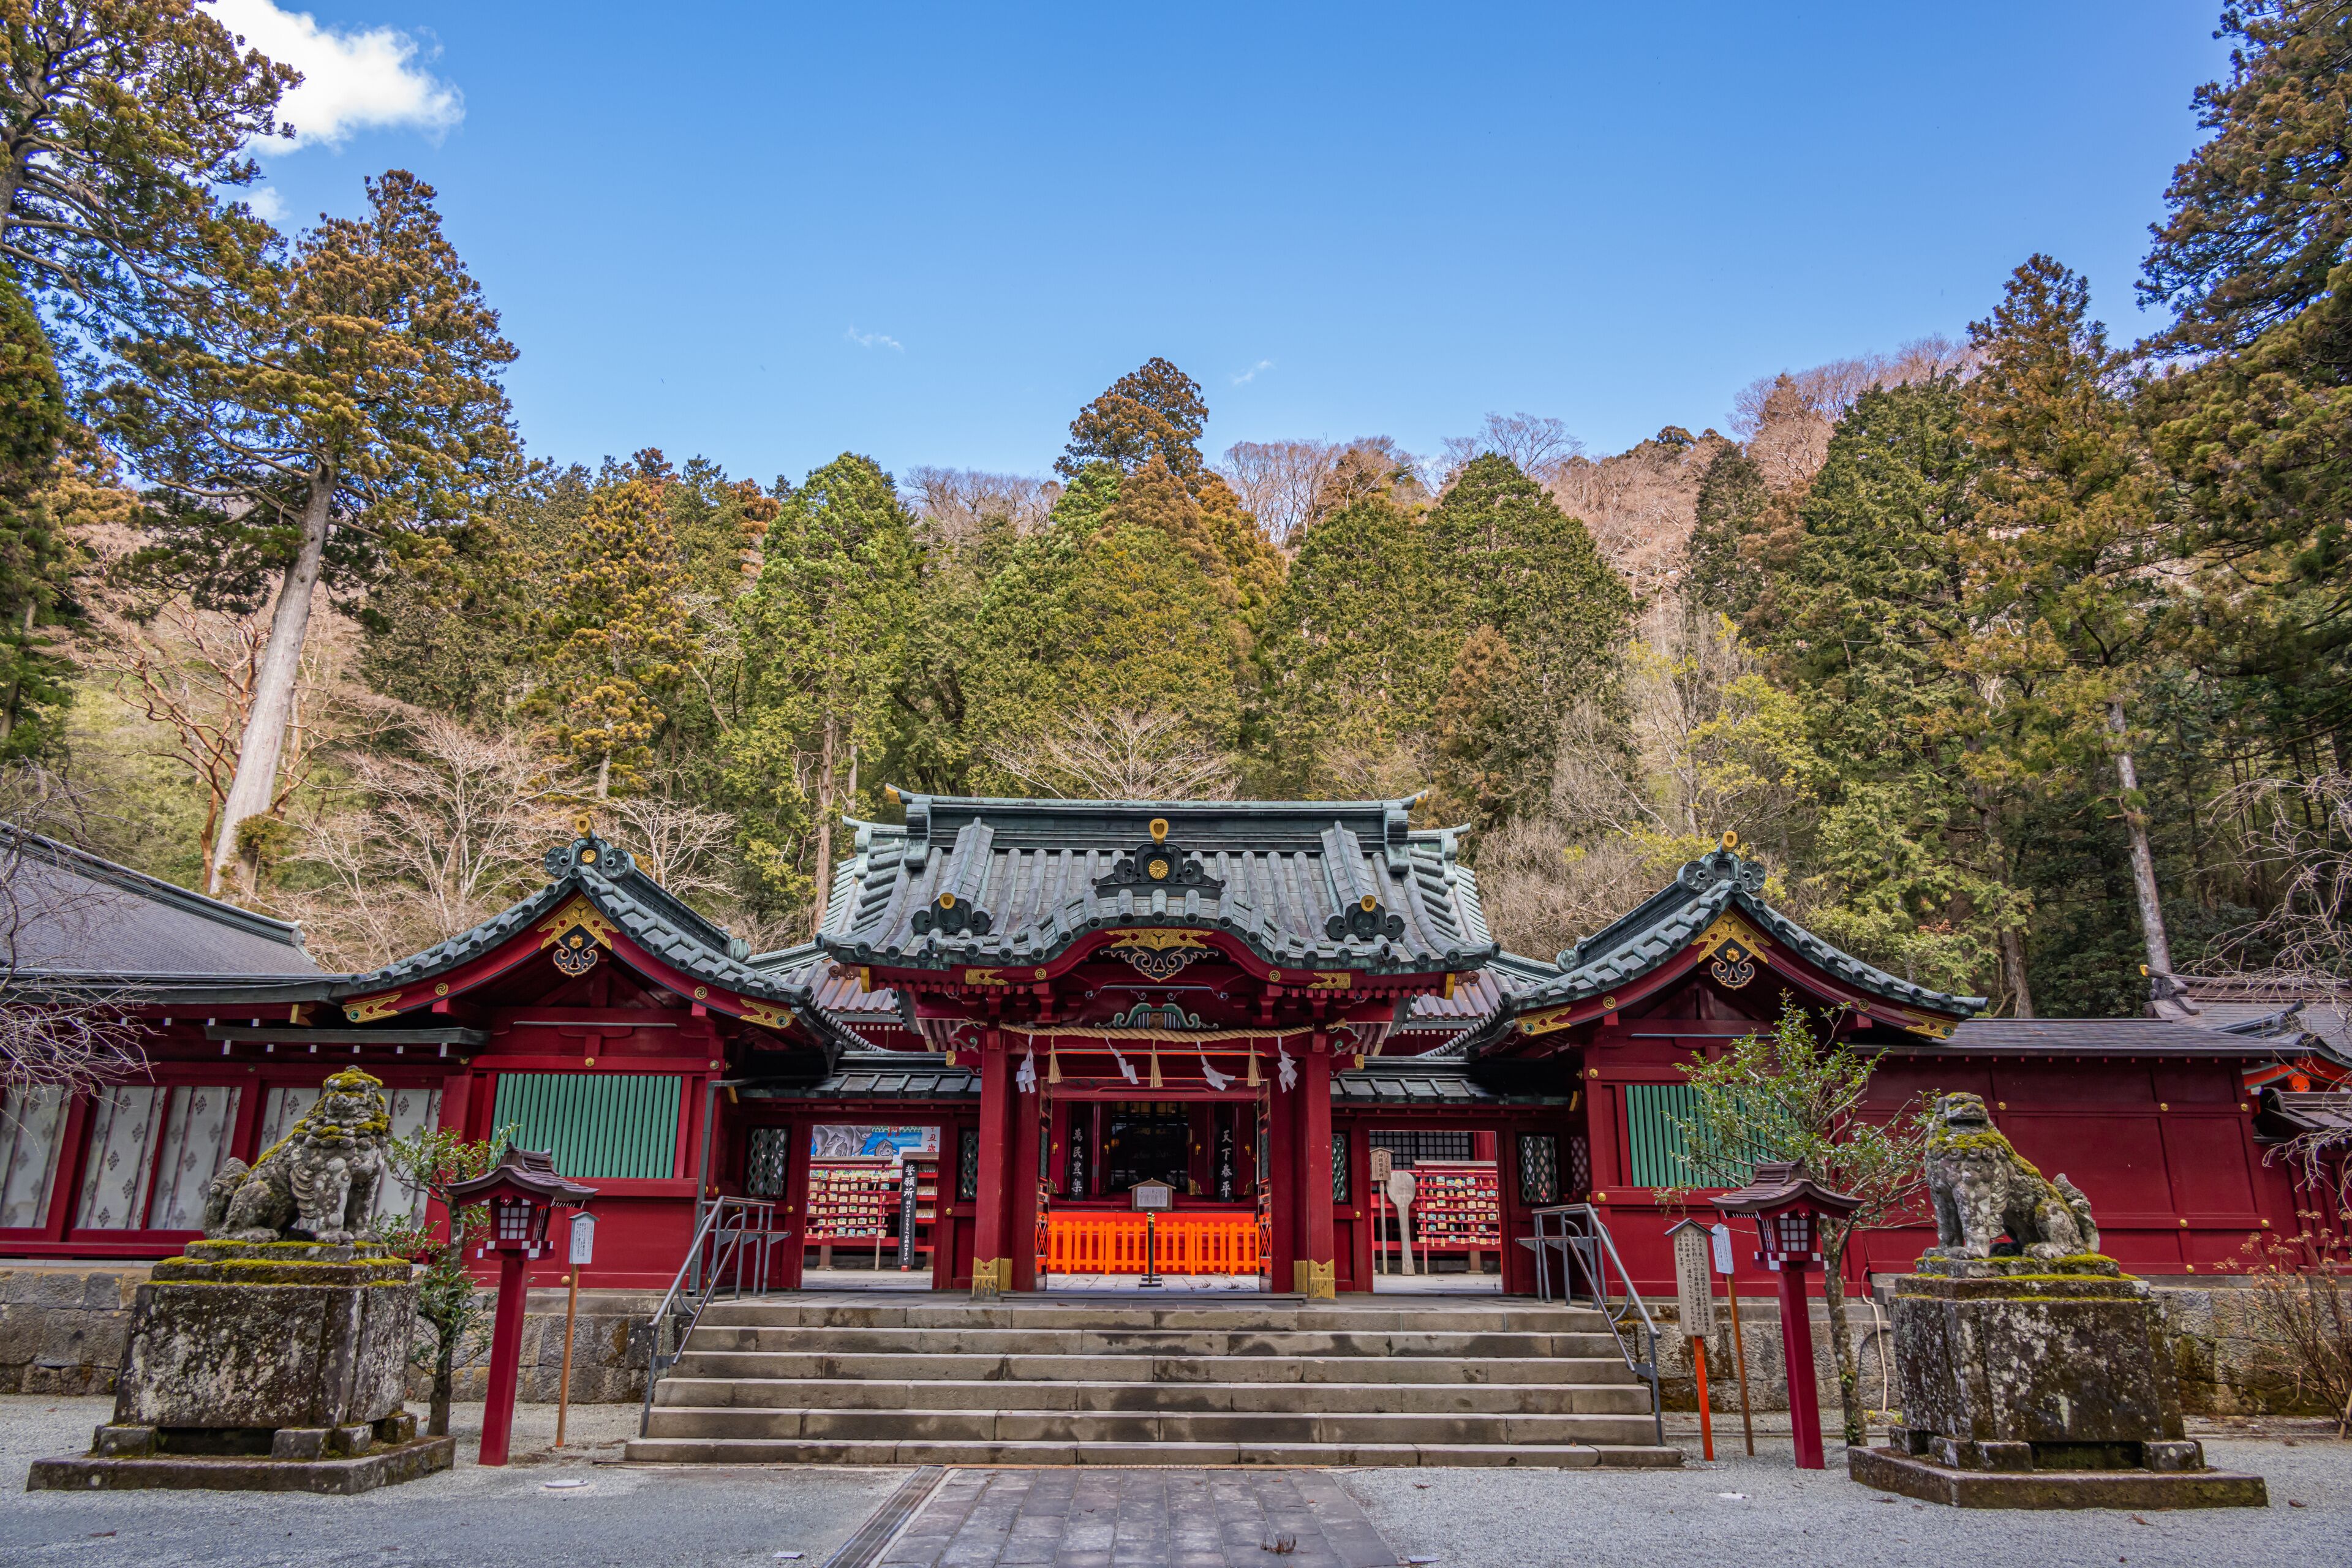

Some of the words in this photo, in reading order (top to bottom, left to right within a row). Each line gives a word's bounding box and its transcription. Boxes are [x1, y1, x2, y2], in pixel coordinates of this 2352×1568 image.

[903, 1164, 915, 1199] 誓願所
[1221, 1129, 1232, 1197] 天下泰平
